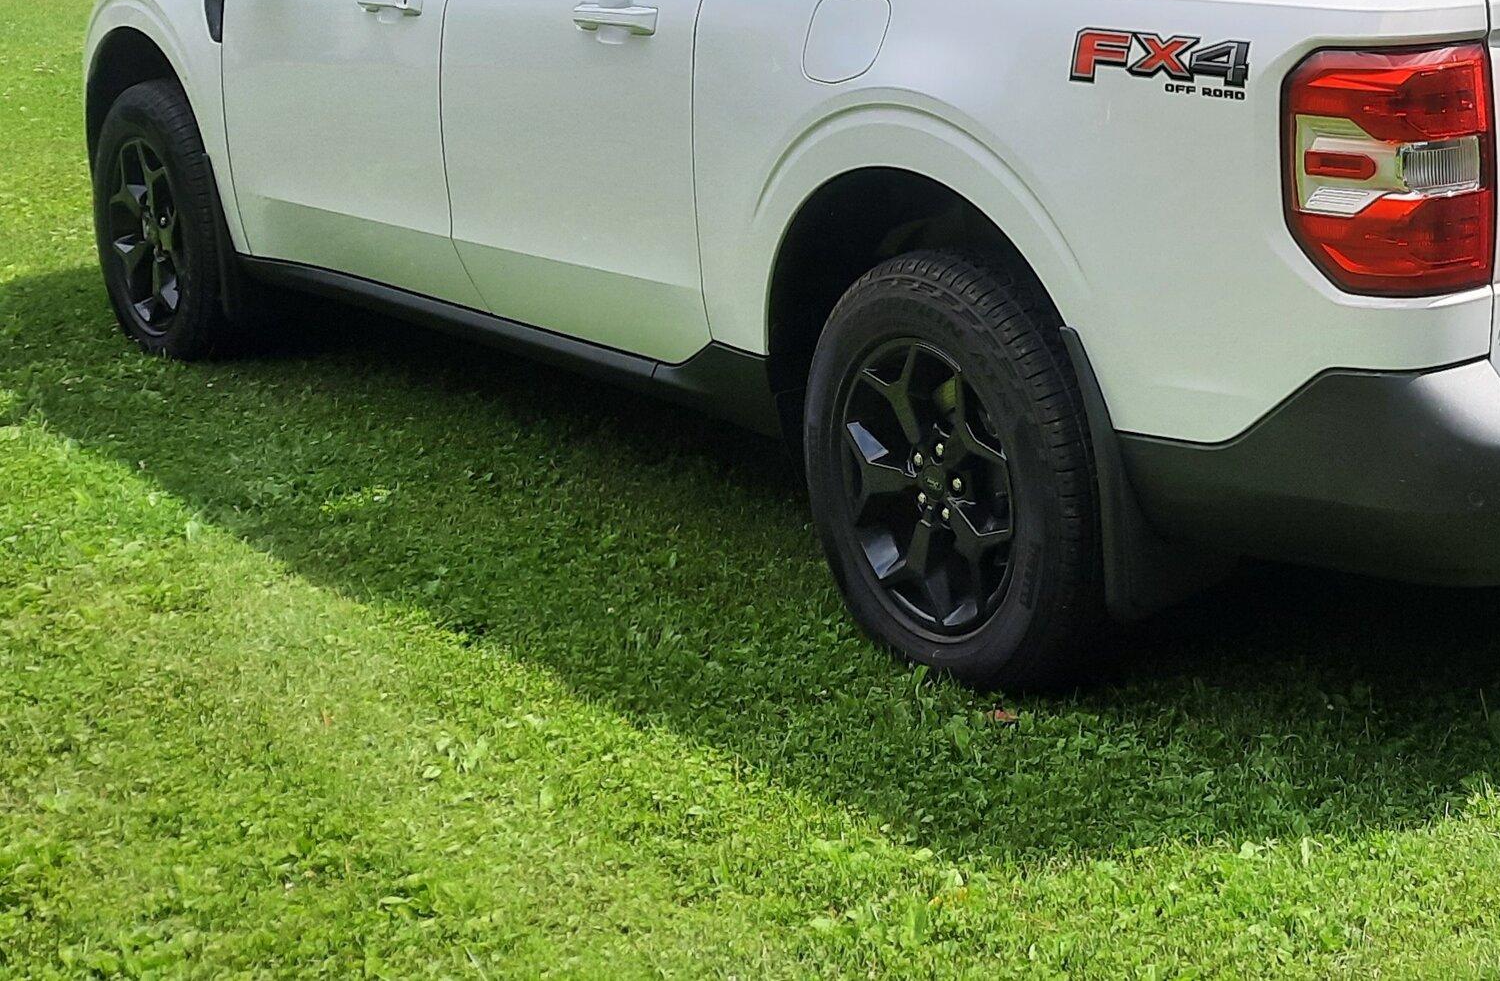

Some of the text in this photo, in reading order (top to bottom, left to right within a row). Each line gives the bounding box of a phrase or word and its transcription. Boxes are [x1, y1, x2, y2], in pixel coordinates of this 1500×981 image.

[1069, 27, 1251, 88] FX4
[1164, 83, 1246, 101] OFF ROAD
